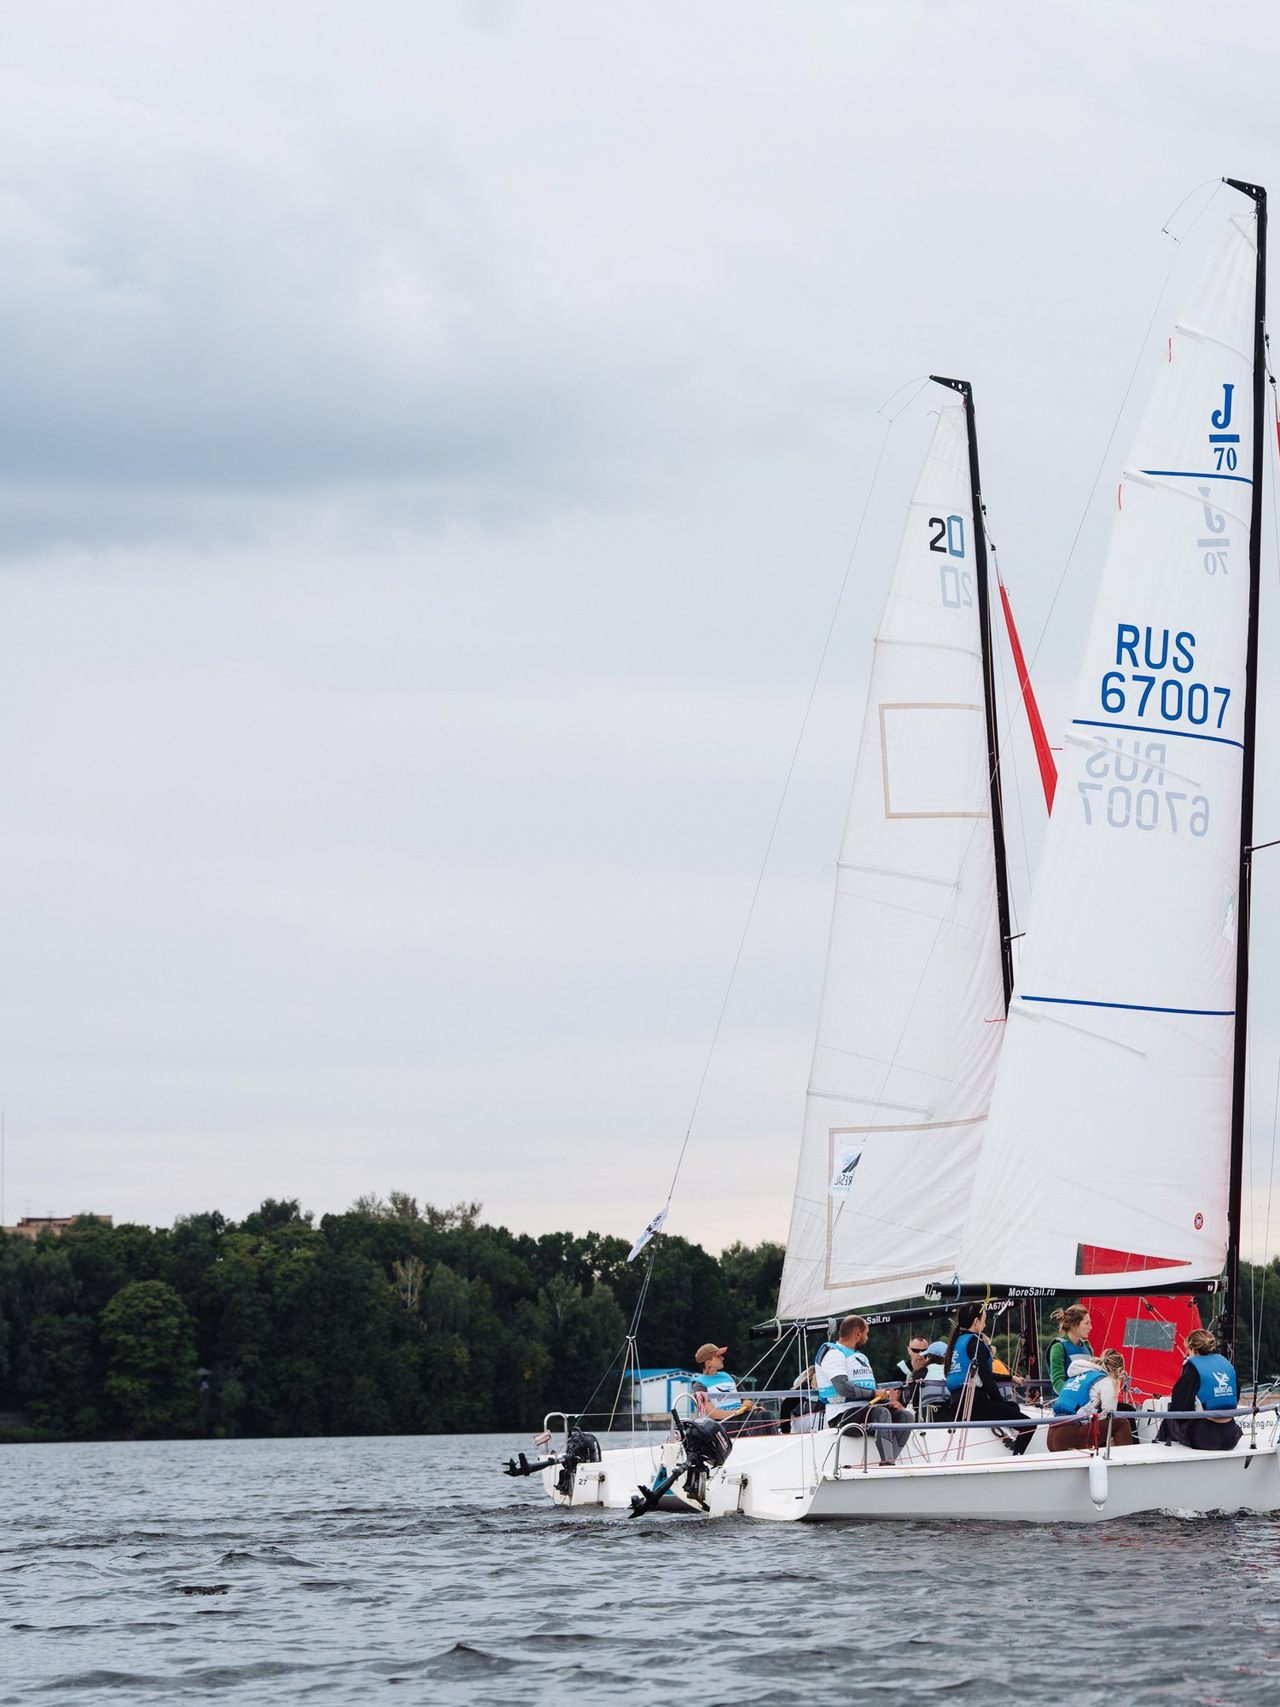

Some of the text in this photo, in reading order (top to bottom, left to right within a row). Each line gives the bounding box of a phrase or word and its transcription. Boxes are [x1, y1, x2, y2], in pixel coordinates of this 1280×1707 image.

[1210, 383, 1236, 430] J
[1212, 447, 1238, 472] 70
[928, 515, 966, 559] 20
[1115, 623, 1197, 674] RUS
[1101, 671, 1232, 729] 67007
[1007, 1287, 1056, 1297] MoreSail.ru
[578, 1478, 588, 1486] 27
